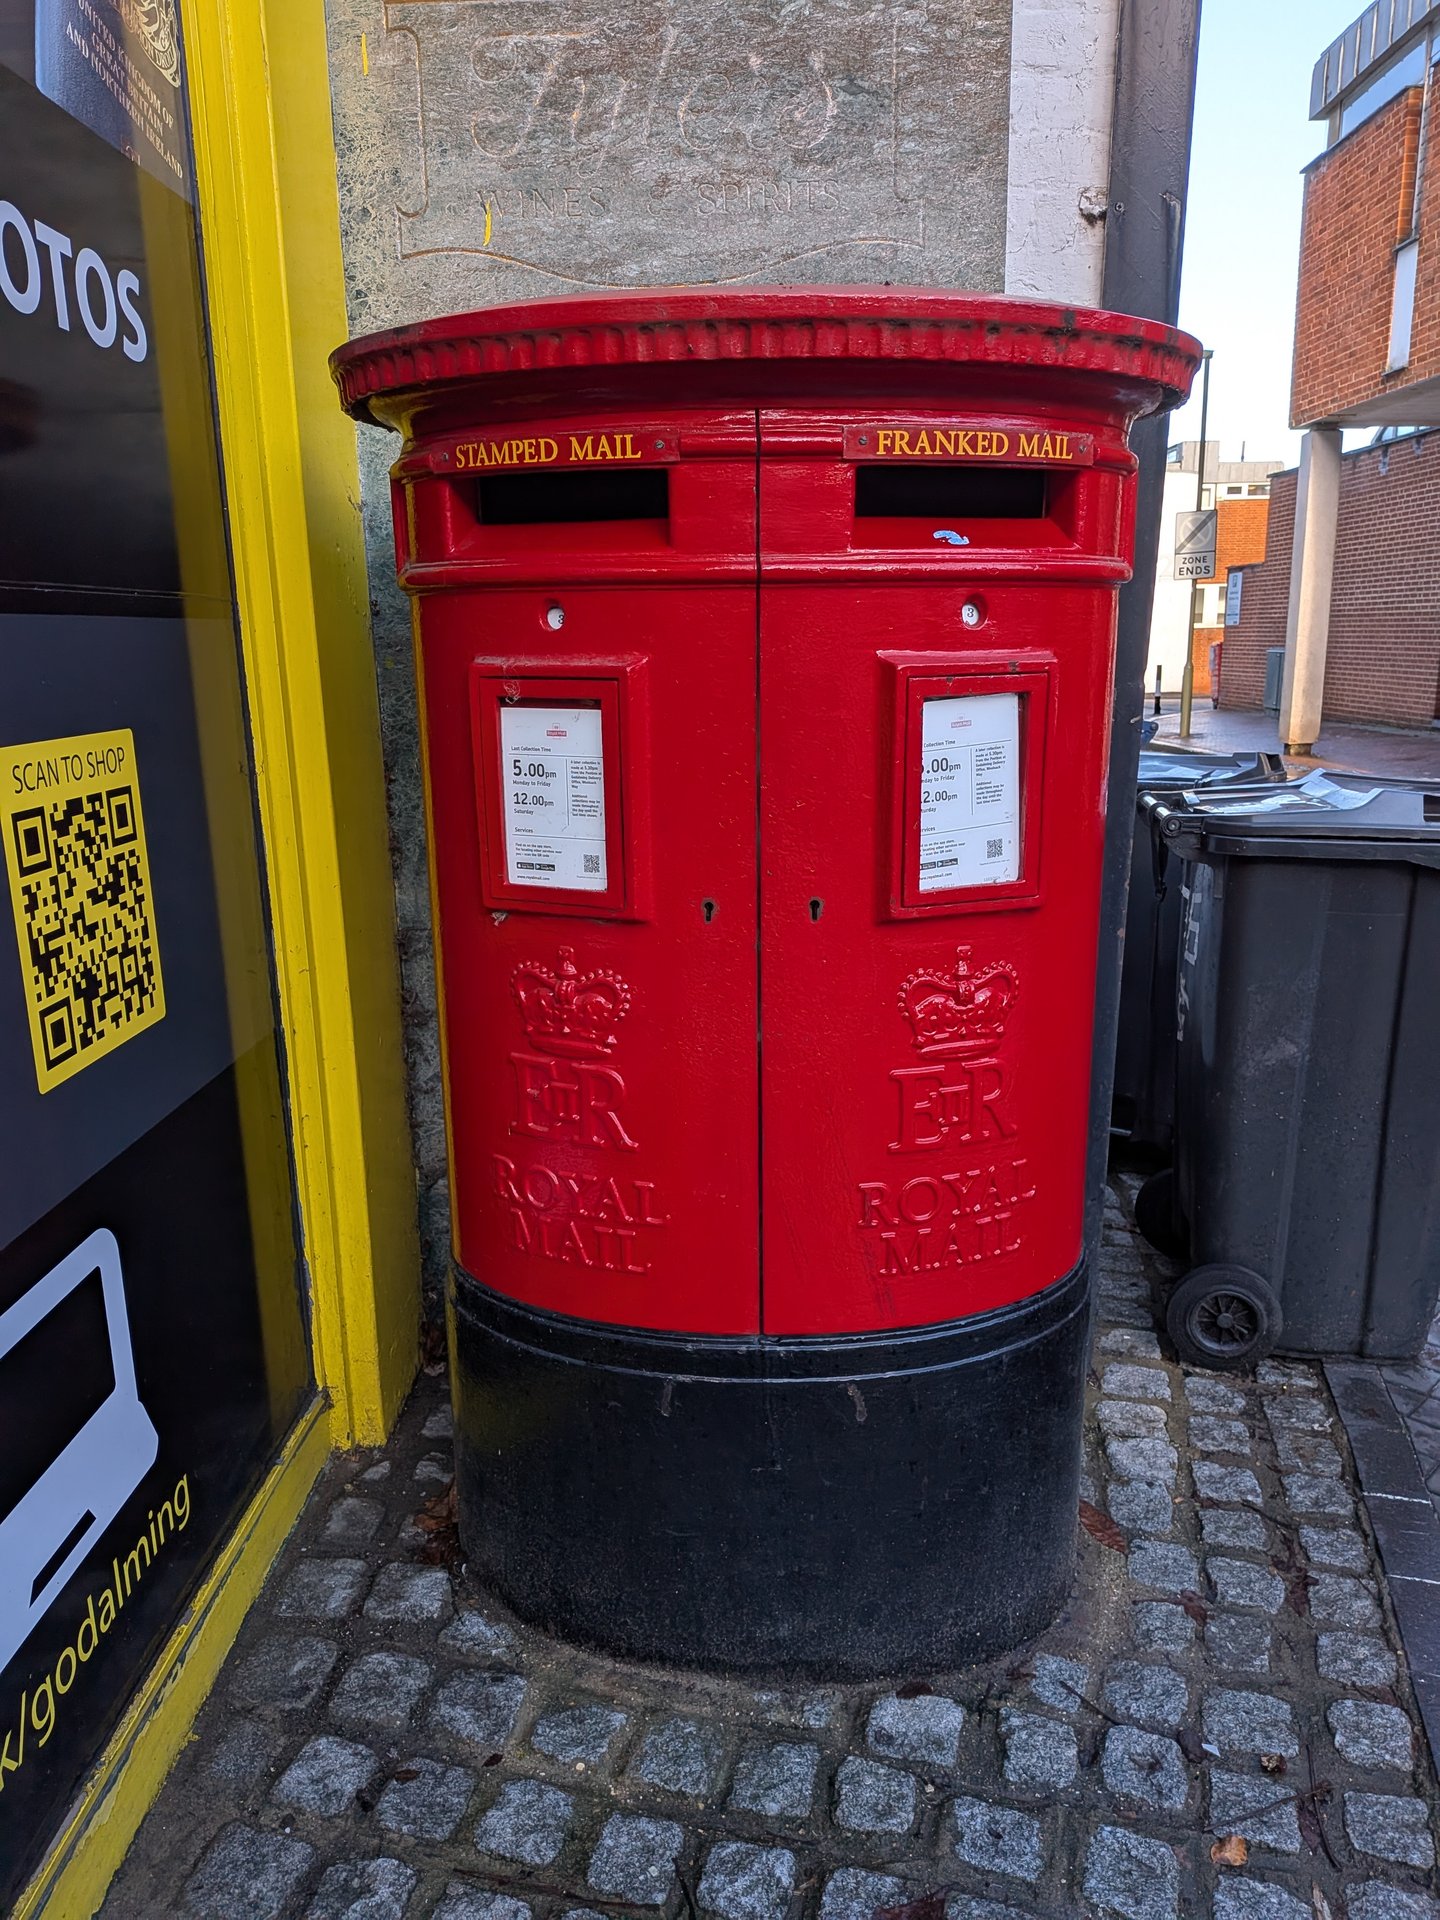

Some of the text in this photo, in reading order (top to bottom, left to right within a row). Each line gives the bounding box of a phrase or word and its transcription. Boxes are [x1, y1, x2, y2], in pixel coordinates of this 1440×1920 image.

[66, 21, 89, 59] AND
[91, 53, 144, 131] NORTHERN
[146, 126, 183, 179] IRELAND
[91, 32, 164, 136] GREAT BRITAIN
[119, 46, 161, 114] KINGDOM
[162, 107, 174, 129] OF
[475, 187, 607, 220] WINES
[698, 178, 840, 217] SPIRITS
[0, 201, 147, 362] OTOS
[456, 434, 642, 469] STAMPED MAIL
[876, 430, 1073, 460] FRANKED MAIL
[1179, 565, 1210, 576] ENDS
[1182, 555, 1208, 564] ZONE
[967, 607, 975, 618] 3
[12, 746, 125, 794] SCAN TO SHOP
[513, 759, 557, 779] 5.00pm
[513, 792, 554, 807] 12.00pm
[921, 790, 958, 804] 2.00pm
[491, 1153, 671, 1226] ROYAL
[857, 1159, 1036, 1227] ROYAL
[510, 1207, 651, 1275] MAIL
[879, 1212, 1021, 1275] MAIL
